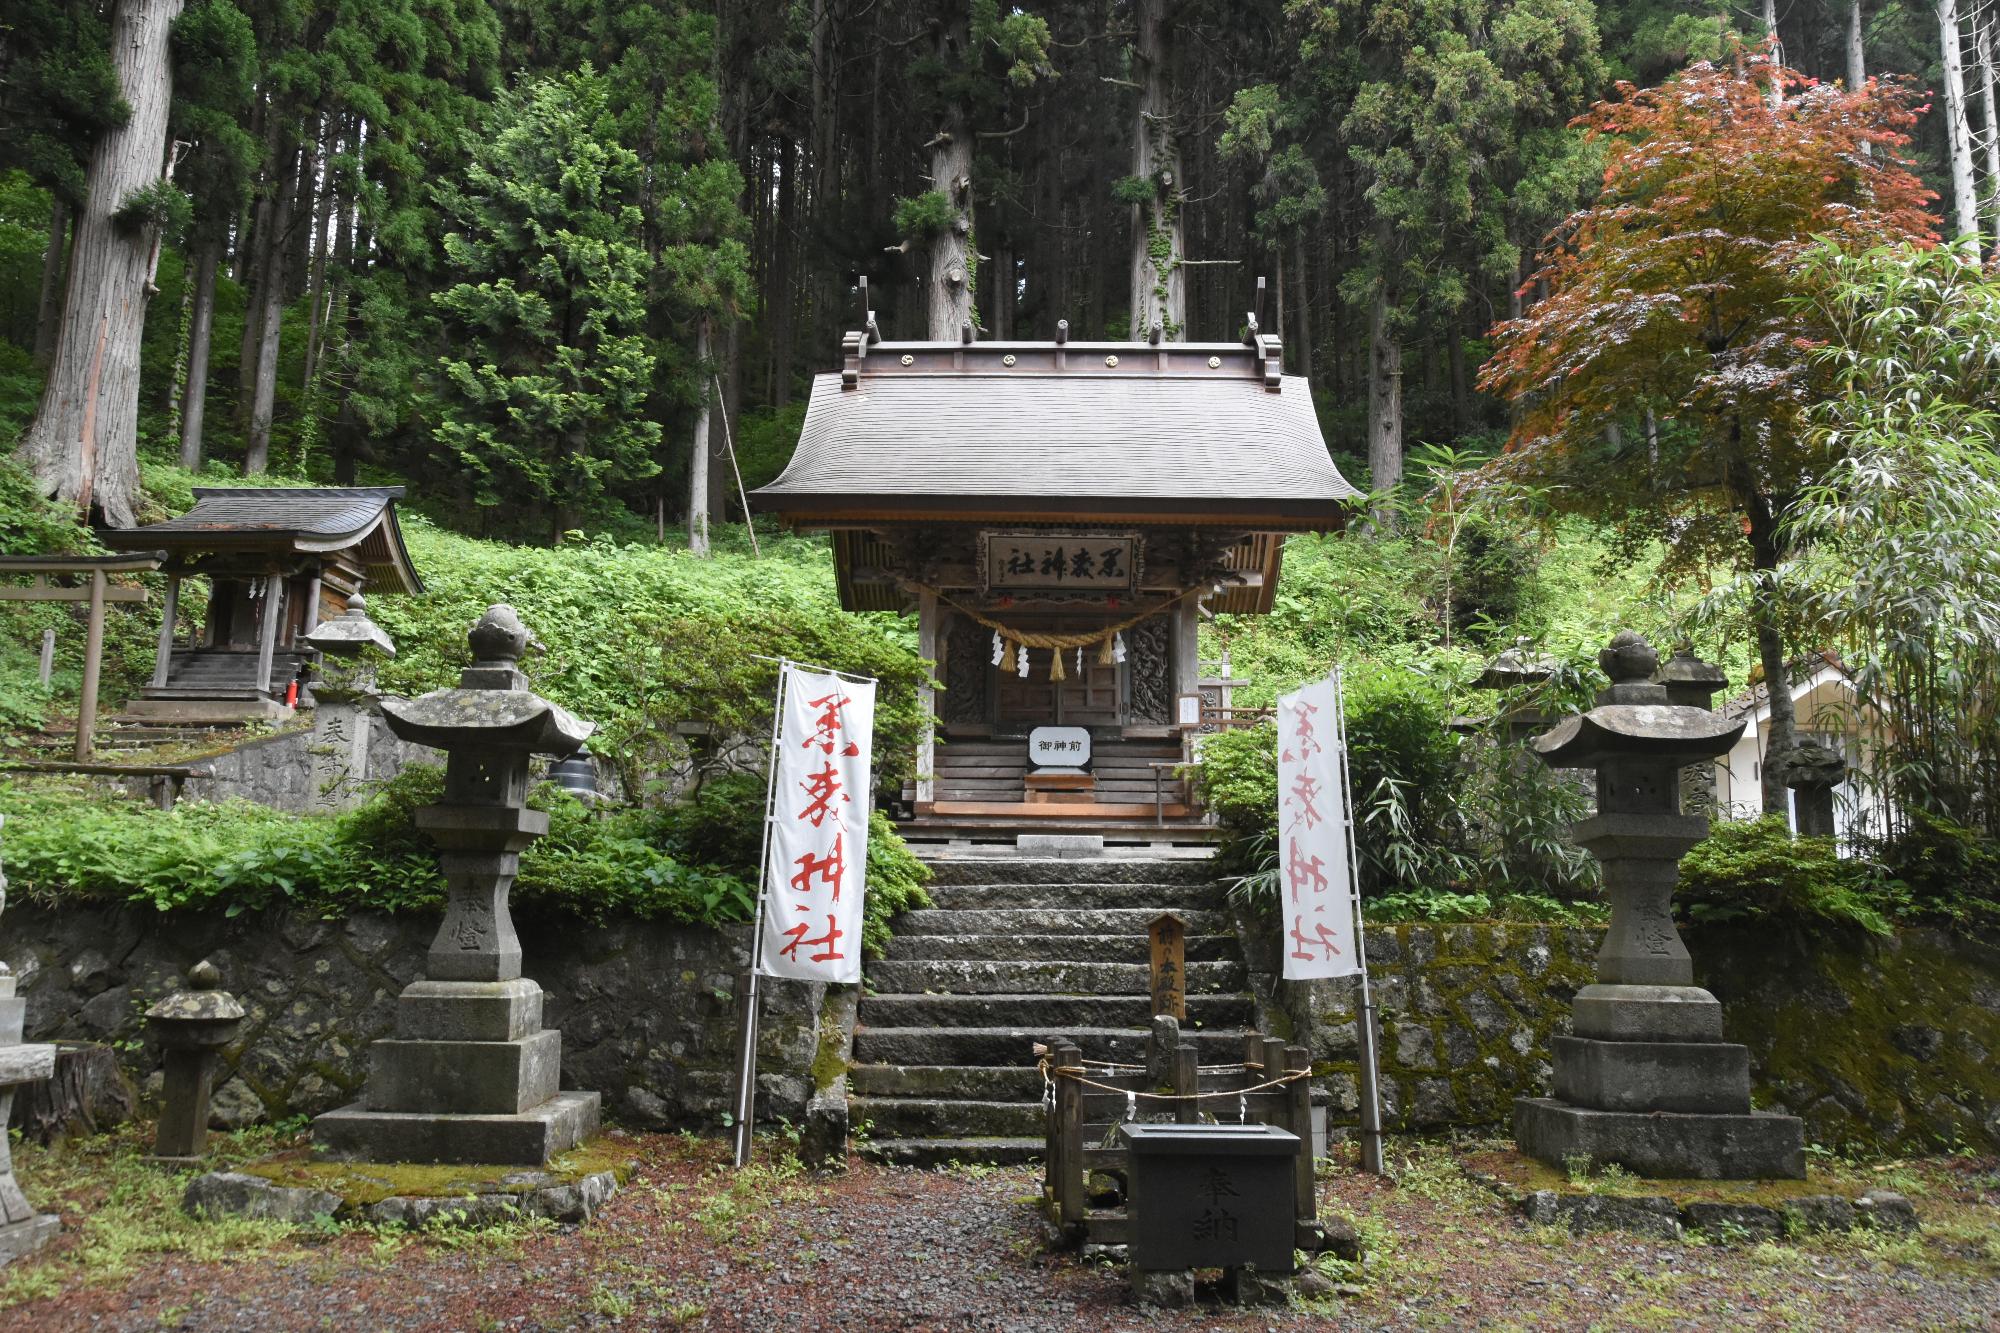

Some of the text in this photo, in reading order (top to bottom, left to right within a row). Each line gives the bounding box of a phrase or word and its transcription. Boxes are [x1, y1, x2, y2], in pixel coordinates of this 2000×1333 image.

[1038, 740, 1082, 752] 御神前
[1192, 1168, 1240, 1242] 奉納
